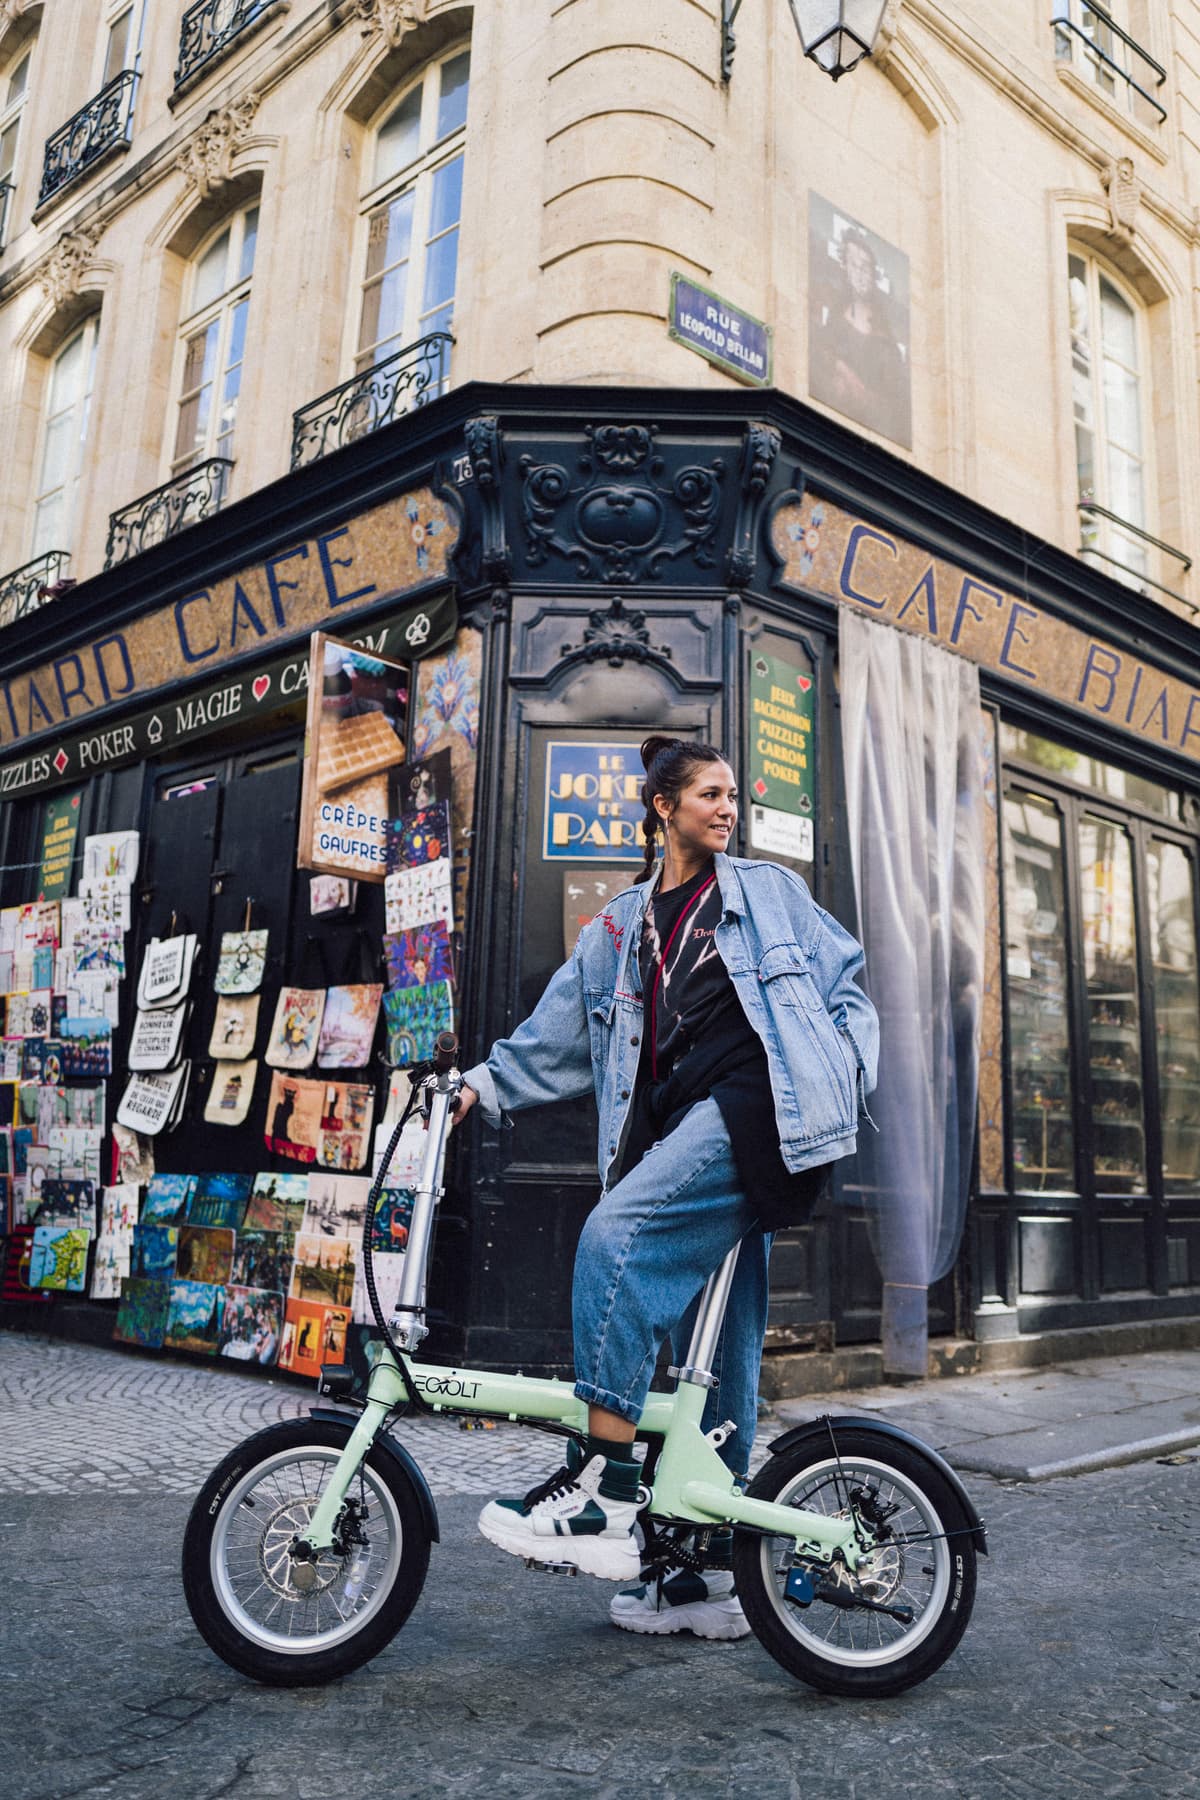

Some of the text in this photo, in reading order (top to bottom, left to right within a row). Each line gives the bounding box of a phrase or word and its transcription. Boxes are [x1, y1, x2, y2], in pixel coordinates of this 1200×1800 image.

[706, 305, 741, 337] RUE
[726, 337, 764, 370] BELLAN
[174, 526, 378, 663] CAFE
[840, 524, 1038, 680] CAFE
[79, 725, 136, 769] POKER
[175, 683, 242, 735] MAGIE
[758, 719, 806, 750] PUZZLES
[598, 754, 625, 771] LE
[756, 738, 808, 769] CARROM
[763, 759, 801, 786] POKER
[321, 804, 388, 835] CRÊPES
[597, 801, 624, 818] DE
[320, 833, 388, 863] GAUFRES
[208, 1492, 222, 1515] CST
[955, 1554, 964, 1579] CST
